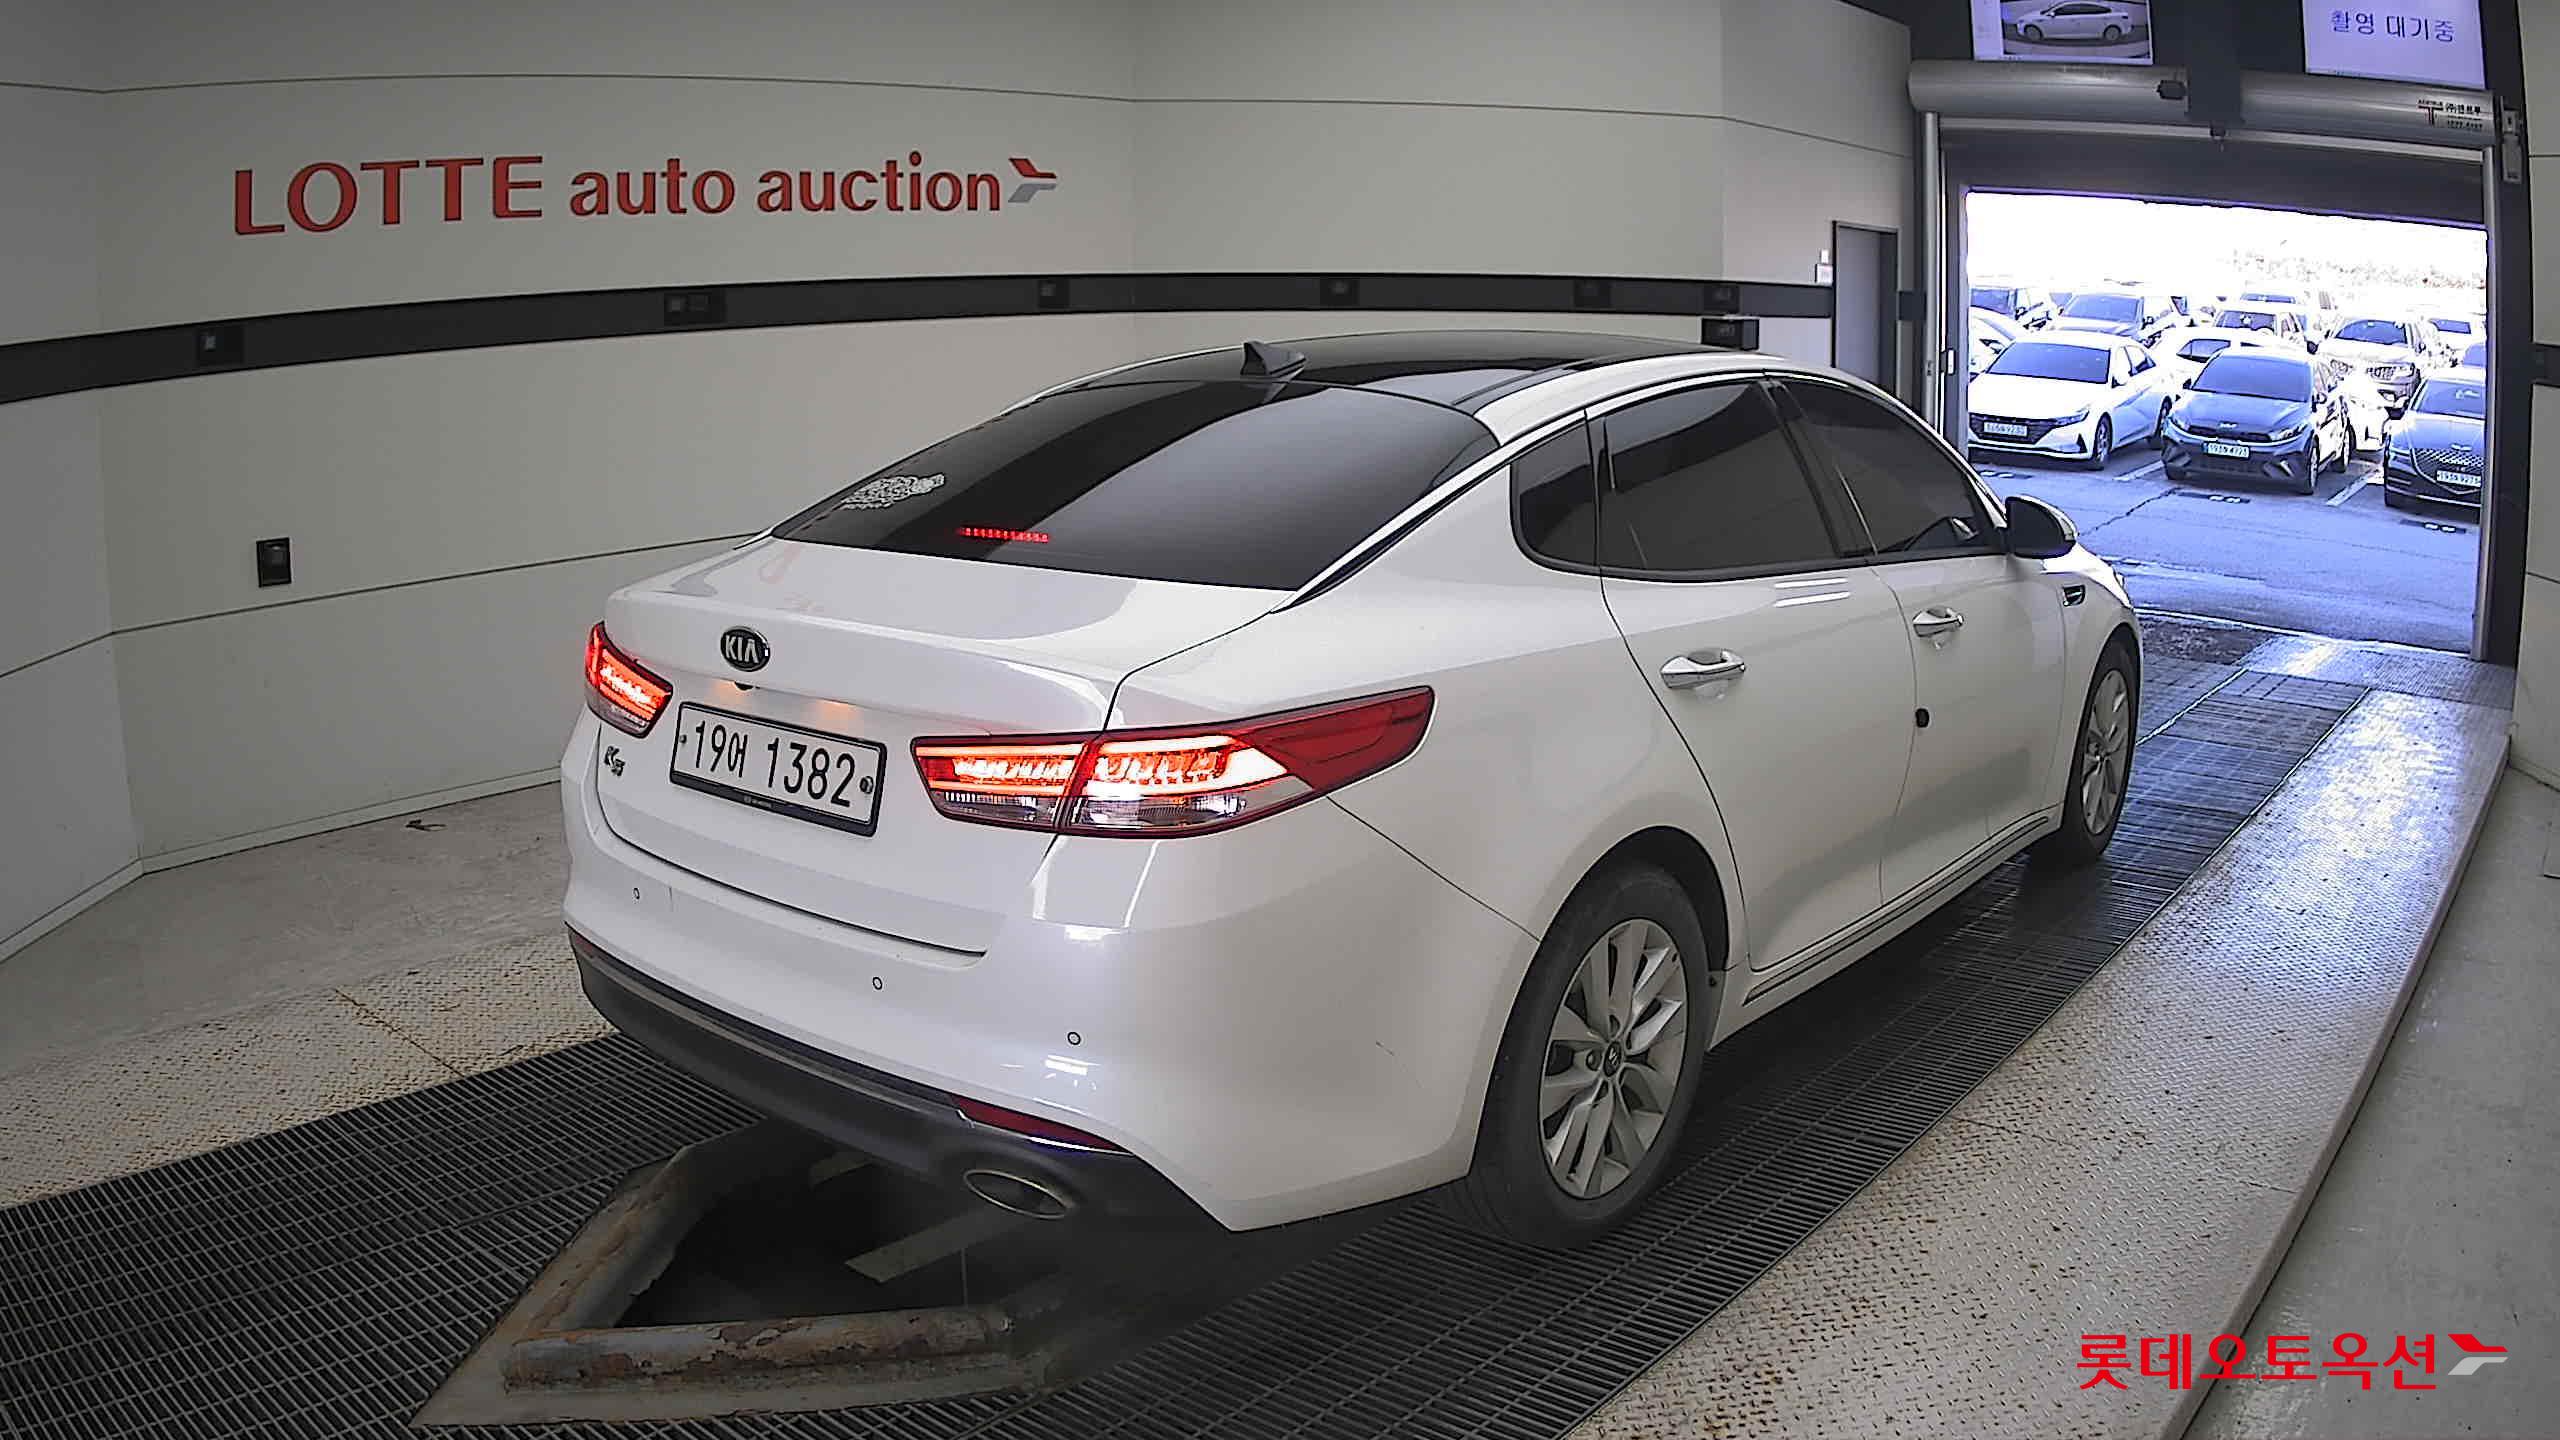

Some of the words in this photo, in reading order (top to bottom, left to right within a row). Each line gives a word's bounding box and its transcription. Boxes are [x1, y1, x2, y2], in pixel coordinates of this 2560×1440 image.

[2331, 10, 2375, 36] 촬영
[2386, 15, 2454, 43] 대기중
[234, 154, 543, 236] LOTTE
[569, 158, 737, 218] auto
[756, 150, 1003, 213] auction
[725, 634, 760, 665] KIA
[695, 720, 749, 778] 19어
[767, 737, 856, 808] 1382
